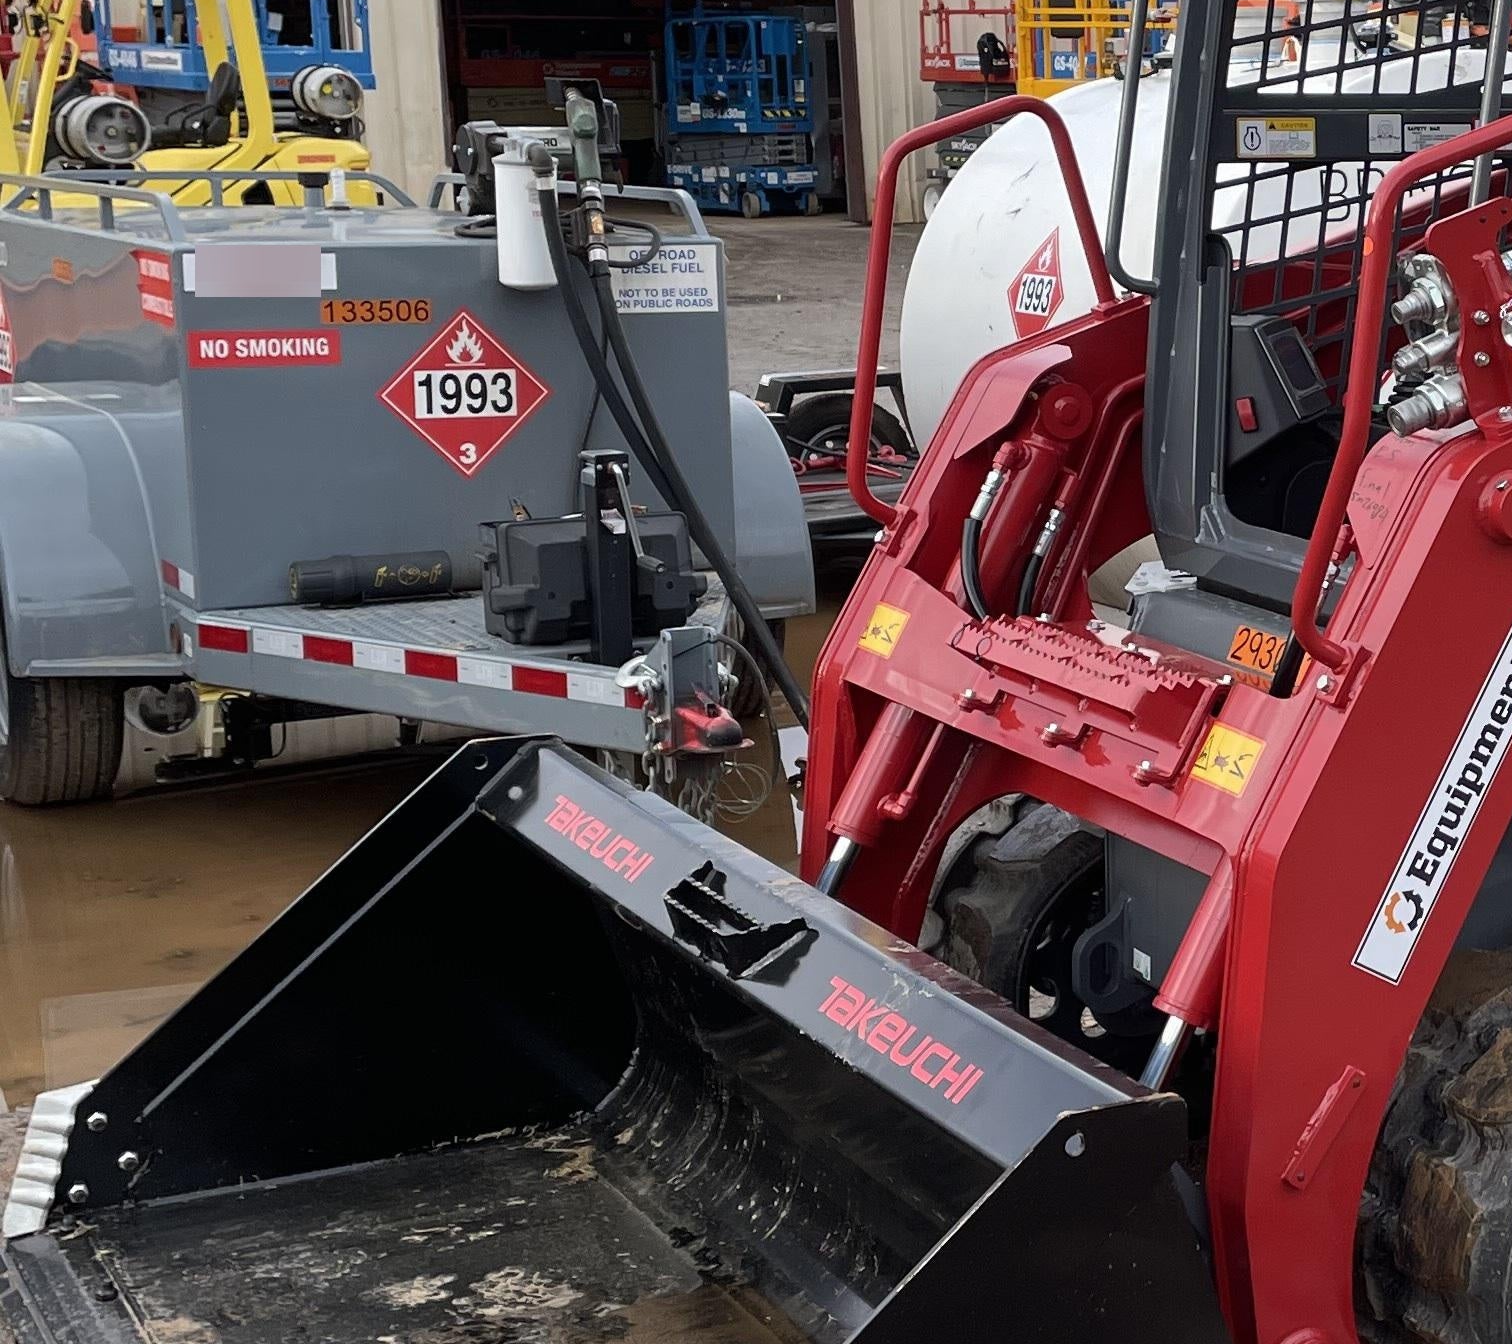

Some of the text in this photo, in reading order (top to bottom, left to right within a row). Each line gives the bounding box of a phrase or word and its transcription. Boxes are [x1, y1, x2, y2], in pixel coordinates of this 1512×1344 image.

[659, 250, 696, 260] ROAD
[621, 262, 704, 274] DIESEL FUEL
[616, 298, 713, 309] ON PUBLIC ROADS
[618, 287, 708, 298] NOT TO BE USED
[1019, 276, 1053, 314] 1993
[323, 300, 430, 323] 133506
[200, 337, 330, 358] NO SMOKING
[417, 371, 514, 415] 1993
[459, 442, 477, 464] 3
[544, 794, 656, 884] TAKEUCHI
[817, 975, 985, 1105] TAKEUCHI
